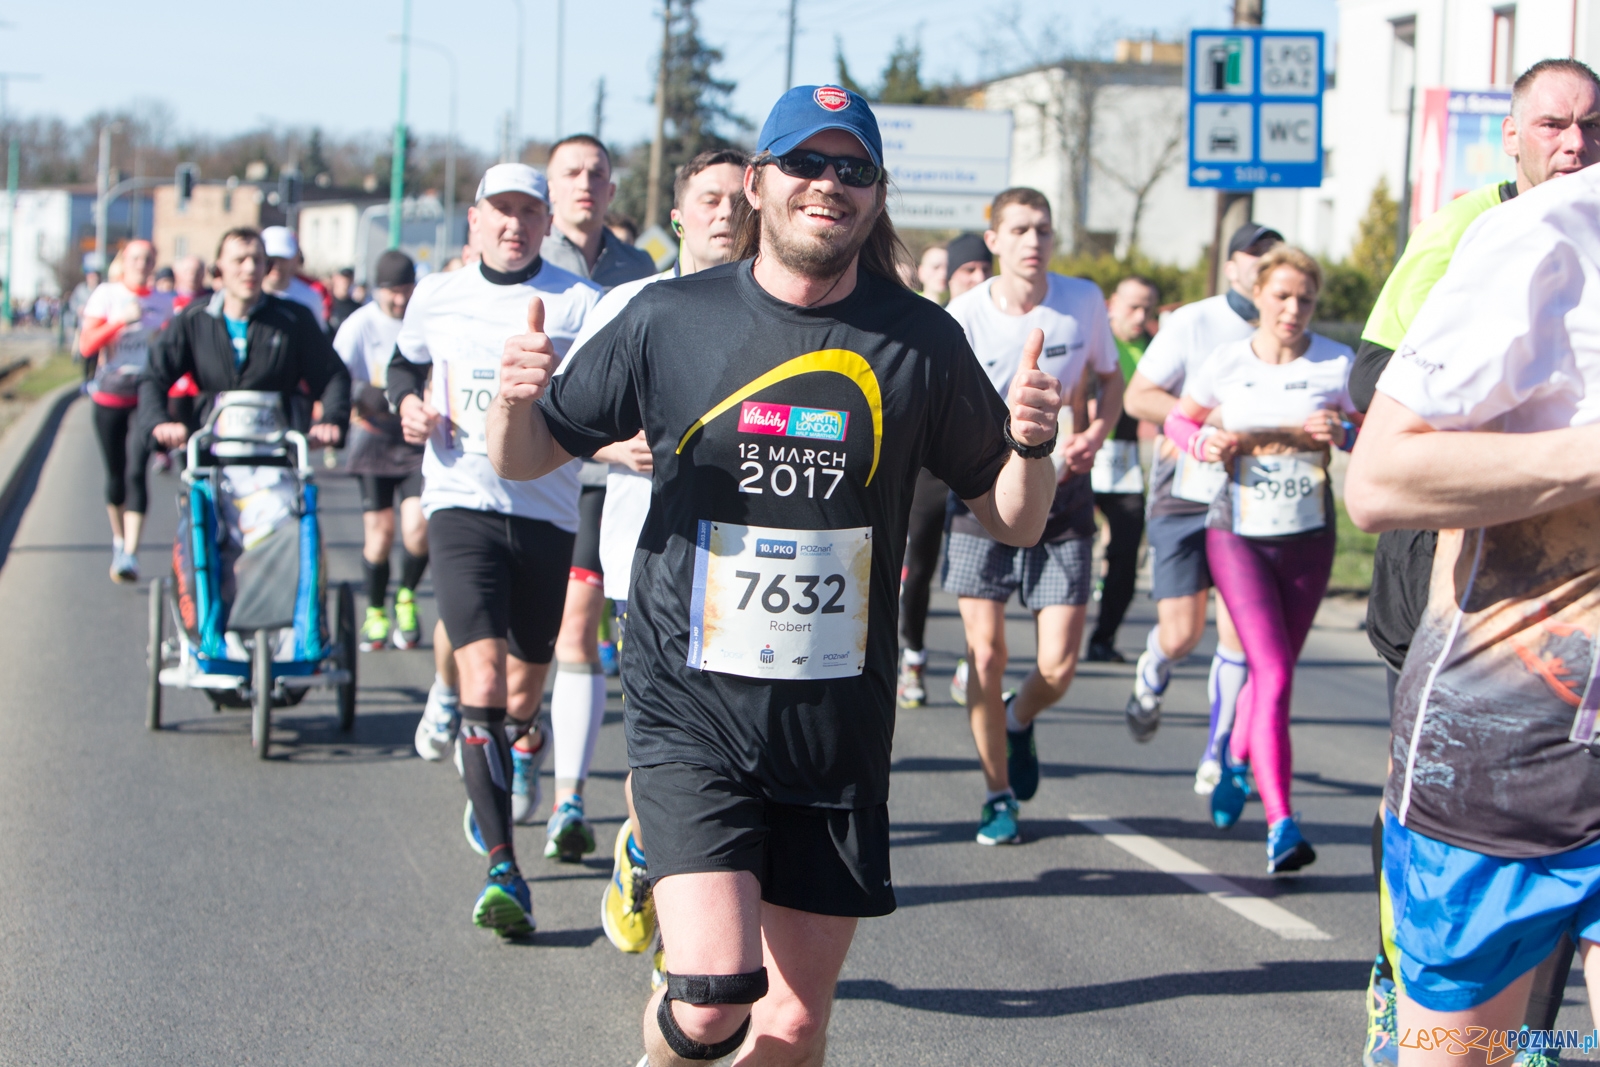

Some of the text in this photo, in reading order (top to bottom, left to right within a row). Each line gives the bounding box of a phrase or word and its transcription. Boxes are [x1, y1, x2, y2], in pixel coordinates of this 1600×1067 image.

[1266, 45, 1311, 64] LPG
[1266, 68, 1311, 88] GAZ
[1266, 119, 1311, 144] WC
[743, 405, 787, 432] Vitality
[795, 420, 838, 434] LONDON
[801, 411, 839, 424] NORTH
[738, 442, 847, 467] 12 MARCH
[738, 461, 845, 500] 2017
[1254, 476, 1313, 500] 5988
[760, 543, 794, 554] 10. PKO
[735, 570, 846, 615] 7632
[769, 620, 812, 633] Robert
[791, 656, 809, 665] 4F
